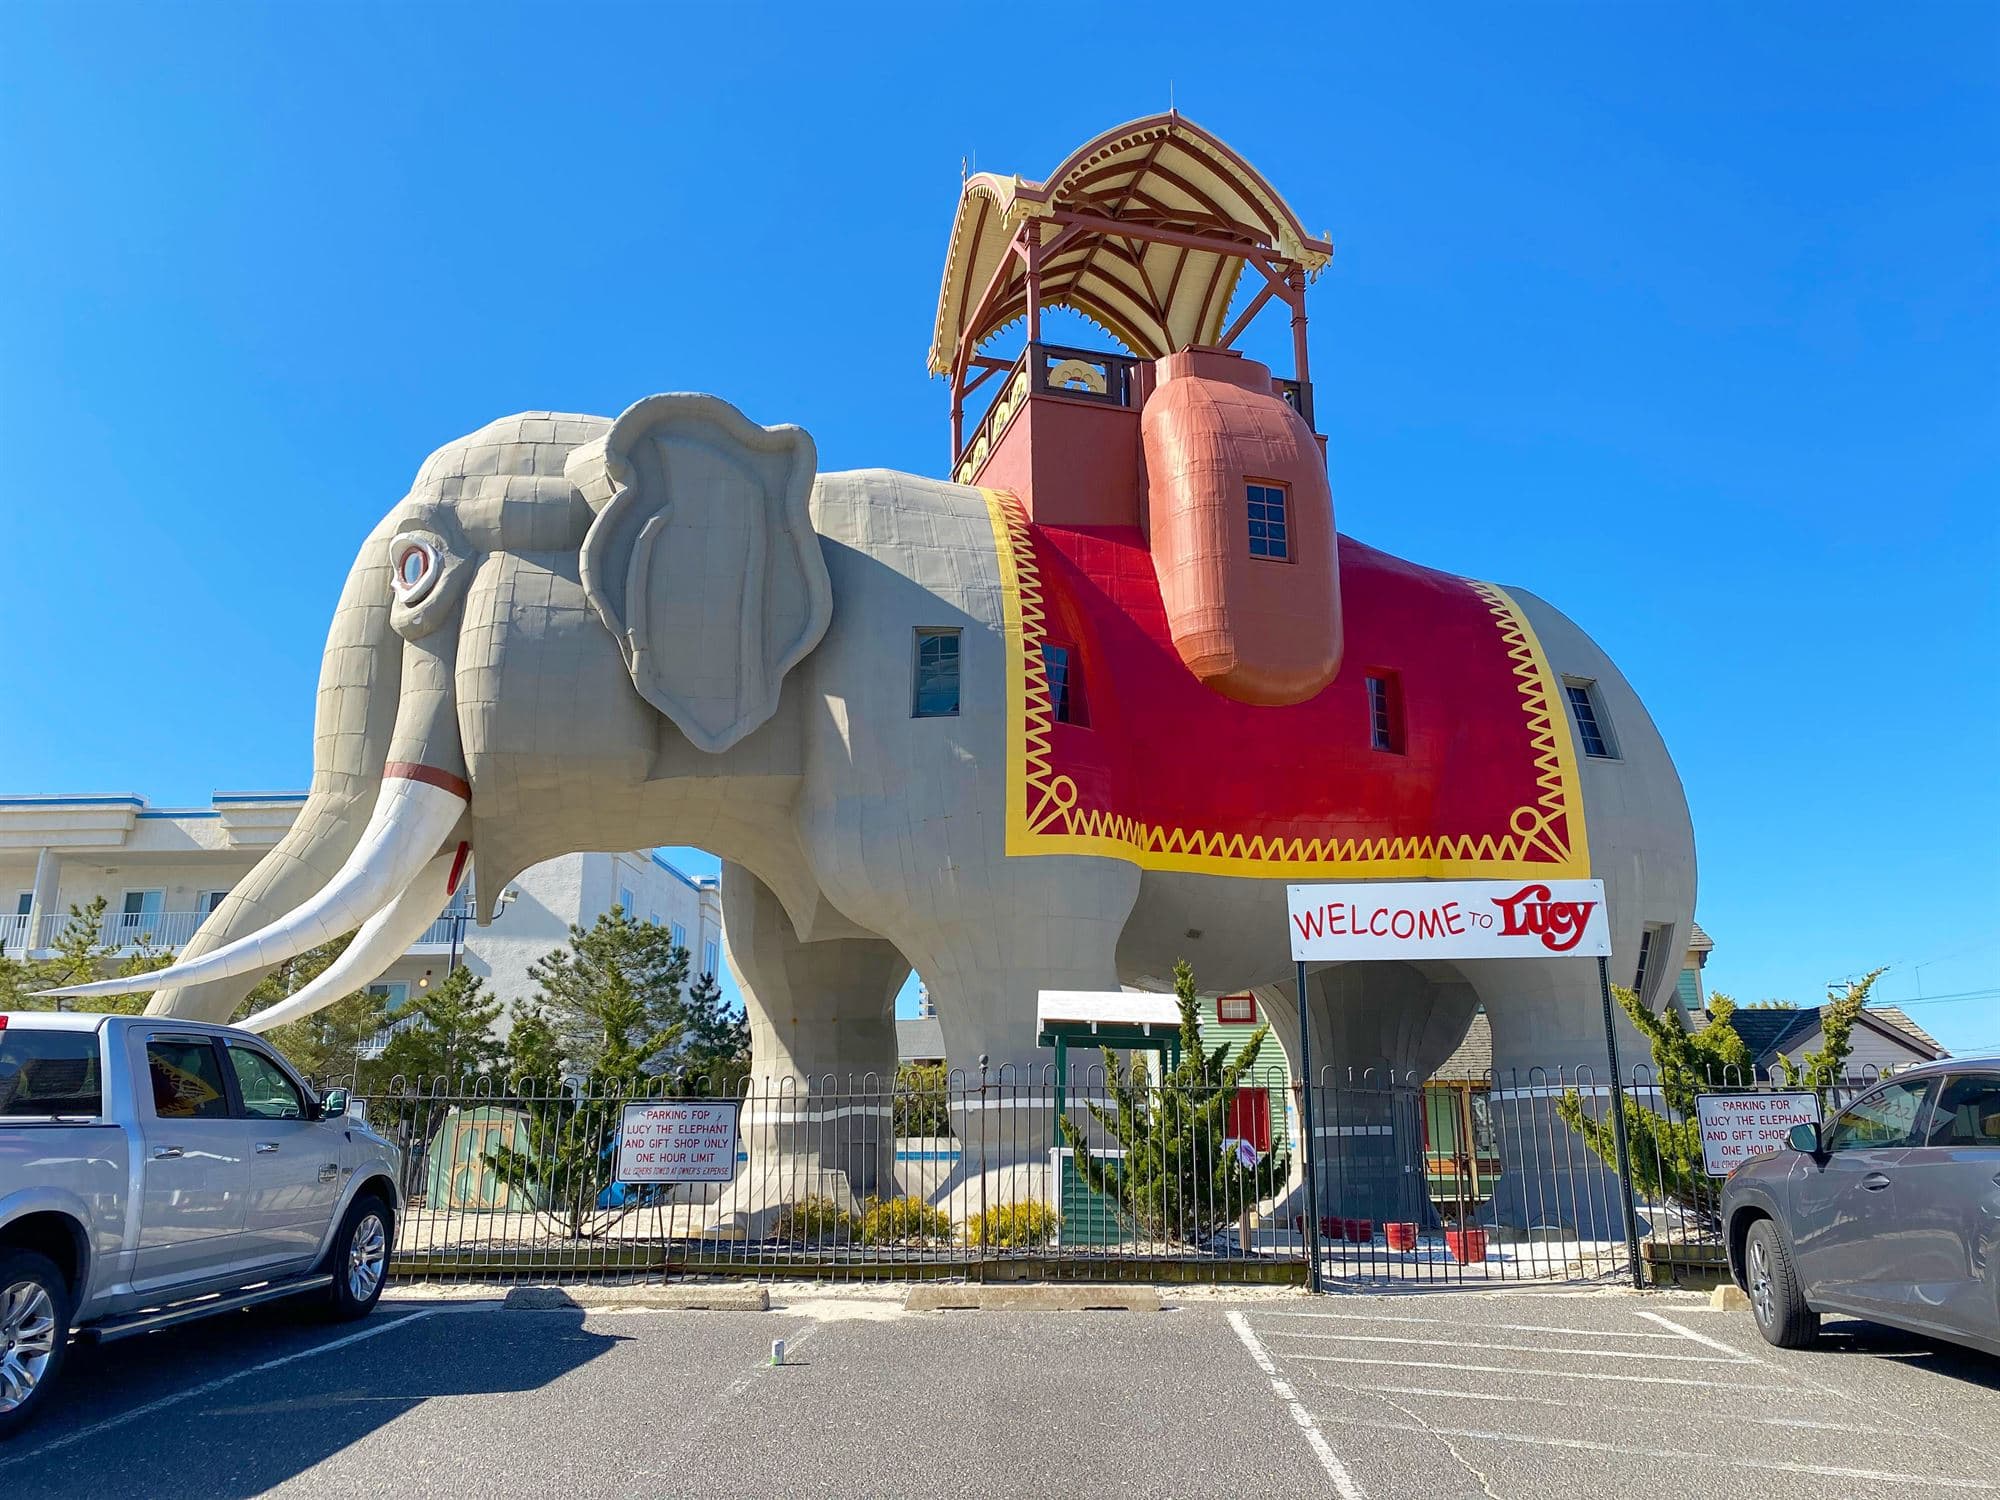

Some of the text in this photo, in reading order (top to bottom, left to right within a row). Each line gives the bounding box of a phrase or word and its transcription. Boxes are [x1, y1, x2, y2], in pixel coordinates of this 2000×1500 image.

[1293, 884, 1598, 952] WELCOME TO Lucy
[1722, 1100, 1790, 1111] PARKING FOR
[646, 1110, 687, 1120] PARKING
[1705, 1114, 1812, 1126] LUCY THE ELEPHANT
[626, 1124, 652, 1134] LUCY
[678, 1124, 728, 1134] ELEPHANT
[1706, 1131, 1728, 1141] AND
[1732, 1130, 1753, 1140] GIFT
[624, 1139, 729, 1148] AND GIFT SHOP ONLY
[1721, 1145, 1742, 1156] ONE
[635, 1153, 715, 1163] ONE HOUR LIMIT
[1711, 1160, 1720, 1169] ALL
[623, 1167, 631, 1176] ALL
[670, 1167, 678, 1176] AT
[702, 1167, 729, 1176] EXPENSE
